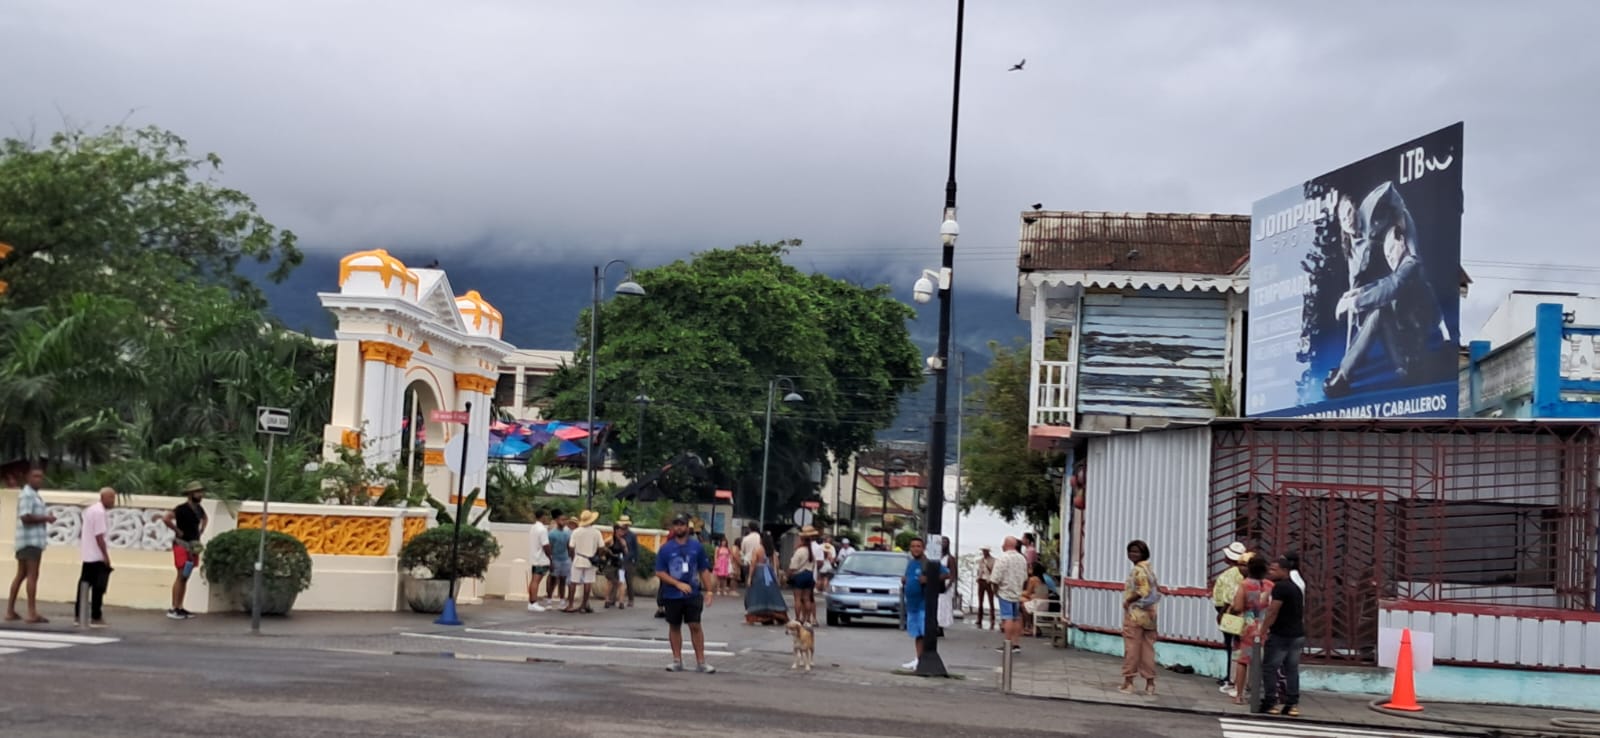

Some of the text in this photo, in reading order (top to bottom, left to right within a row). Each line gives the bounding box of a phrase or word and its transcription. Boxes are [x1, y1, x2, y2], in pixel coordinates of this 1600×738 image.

[1400, 146, 1425, 185] LTB
[1340, 405, 1372, 418] DAMAS
[1373, 403, 1381, 418] Y
[1382, 395, 1447, 417] CABALLEROS
